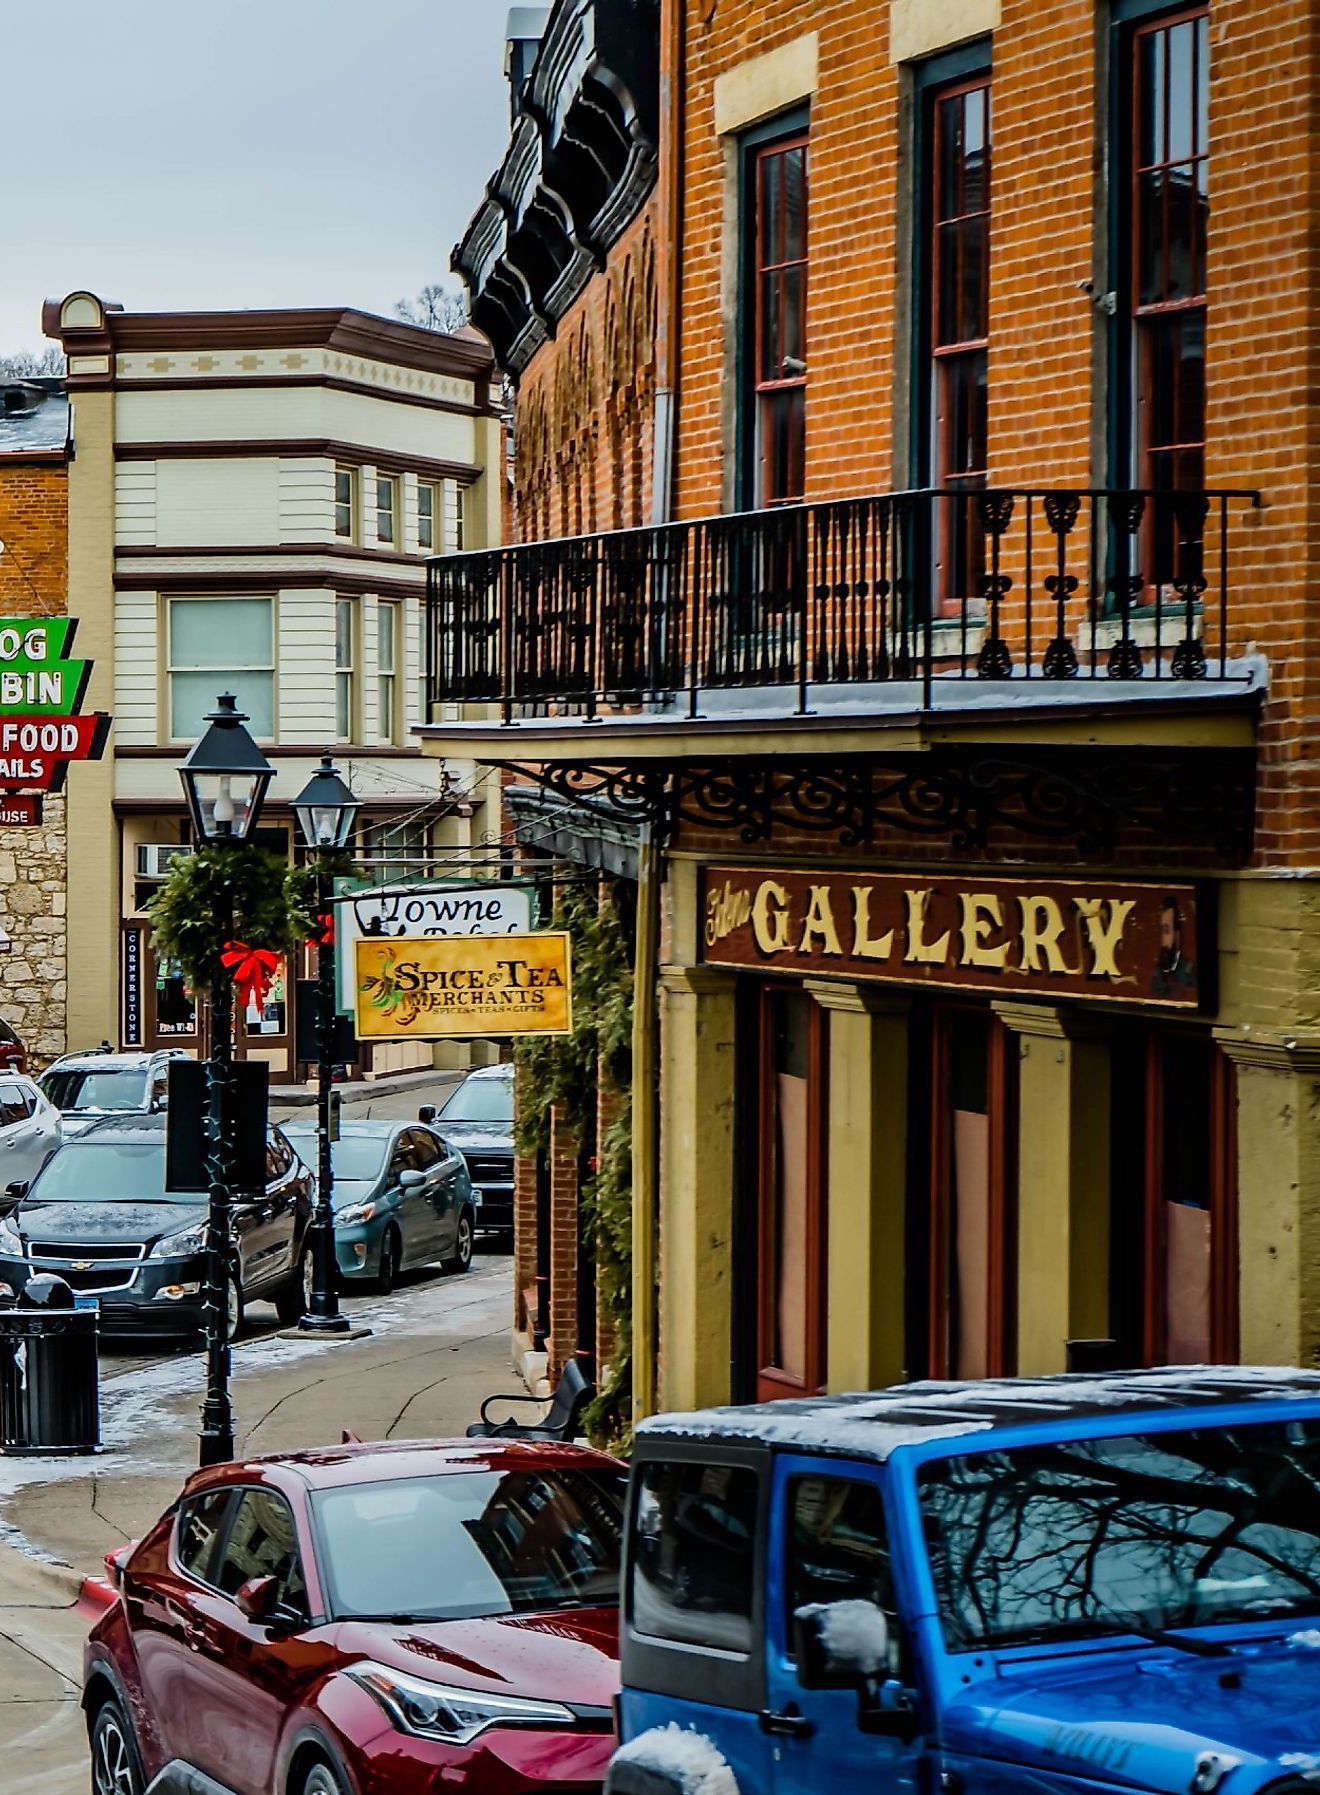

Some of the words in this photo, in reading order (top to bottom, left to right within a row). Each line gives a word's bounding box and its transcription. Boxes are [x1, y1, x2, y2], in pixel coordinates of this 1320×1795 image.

[2, 723, 79, 752] FOOD
[751, 880, 1137, 975] GALLERY
[128, 935, 137, 1041] CORNERSTONE
[394, 962, 483, 992] SPICE
[411, 989, 545, 1006] MERCHANTS
